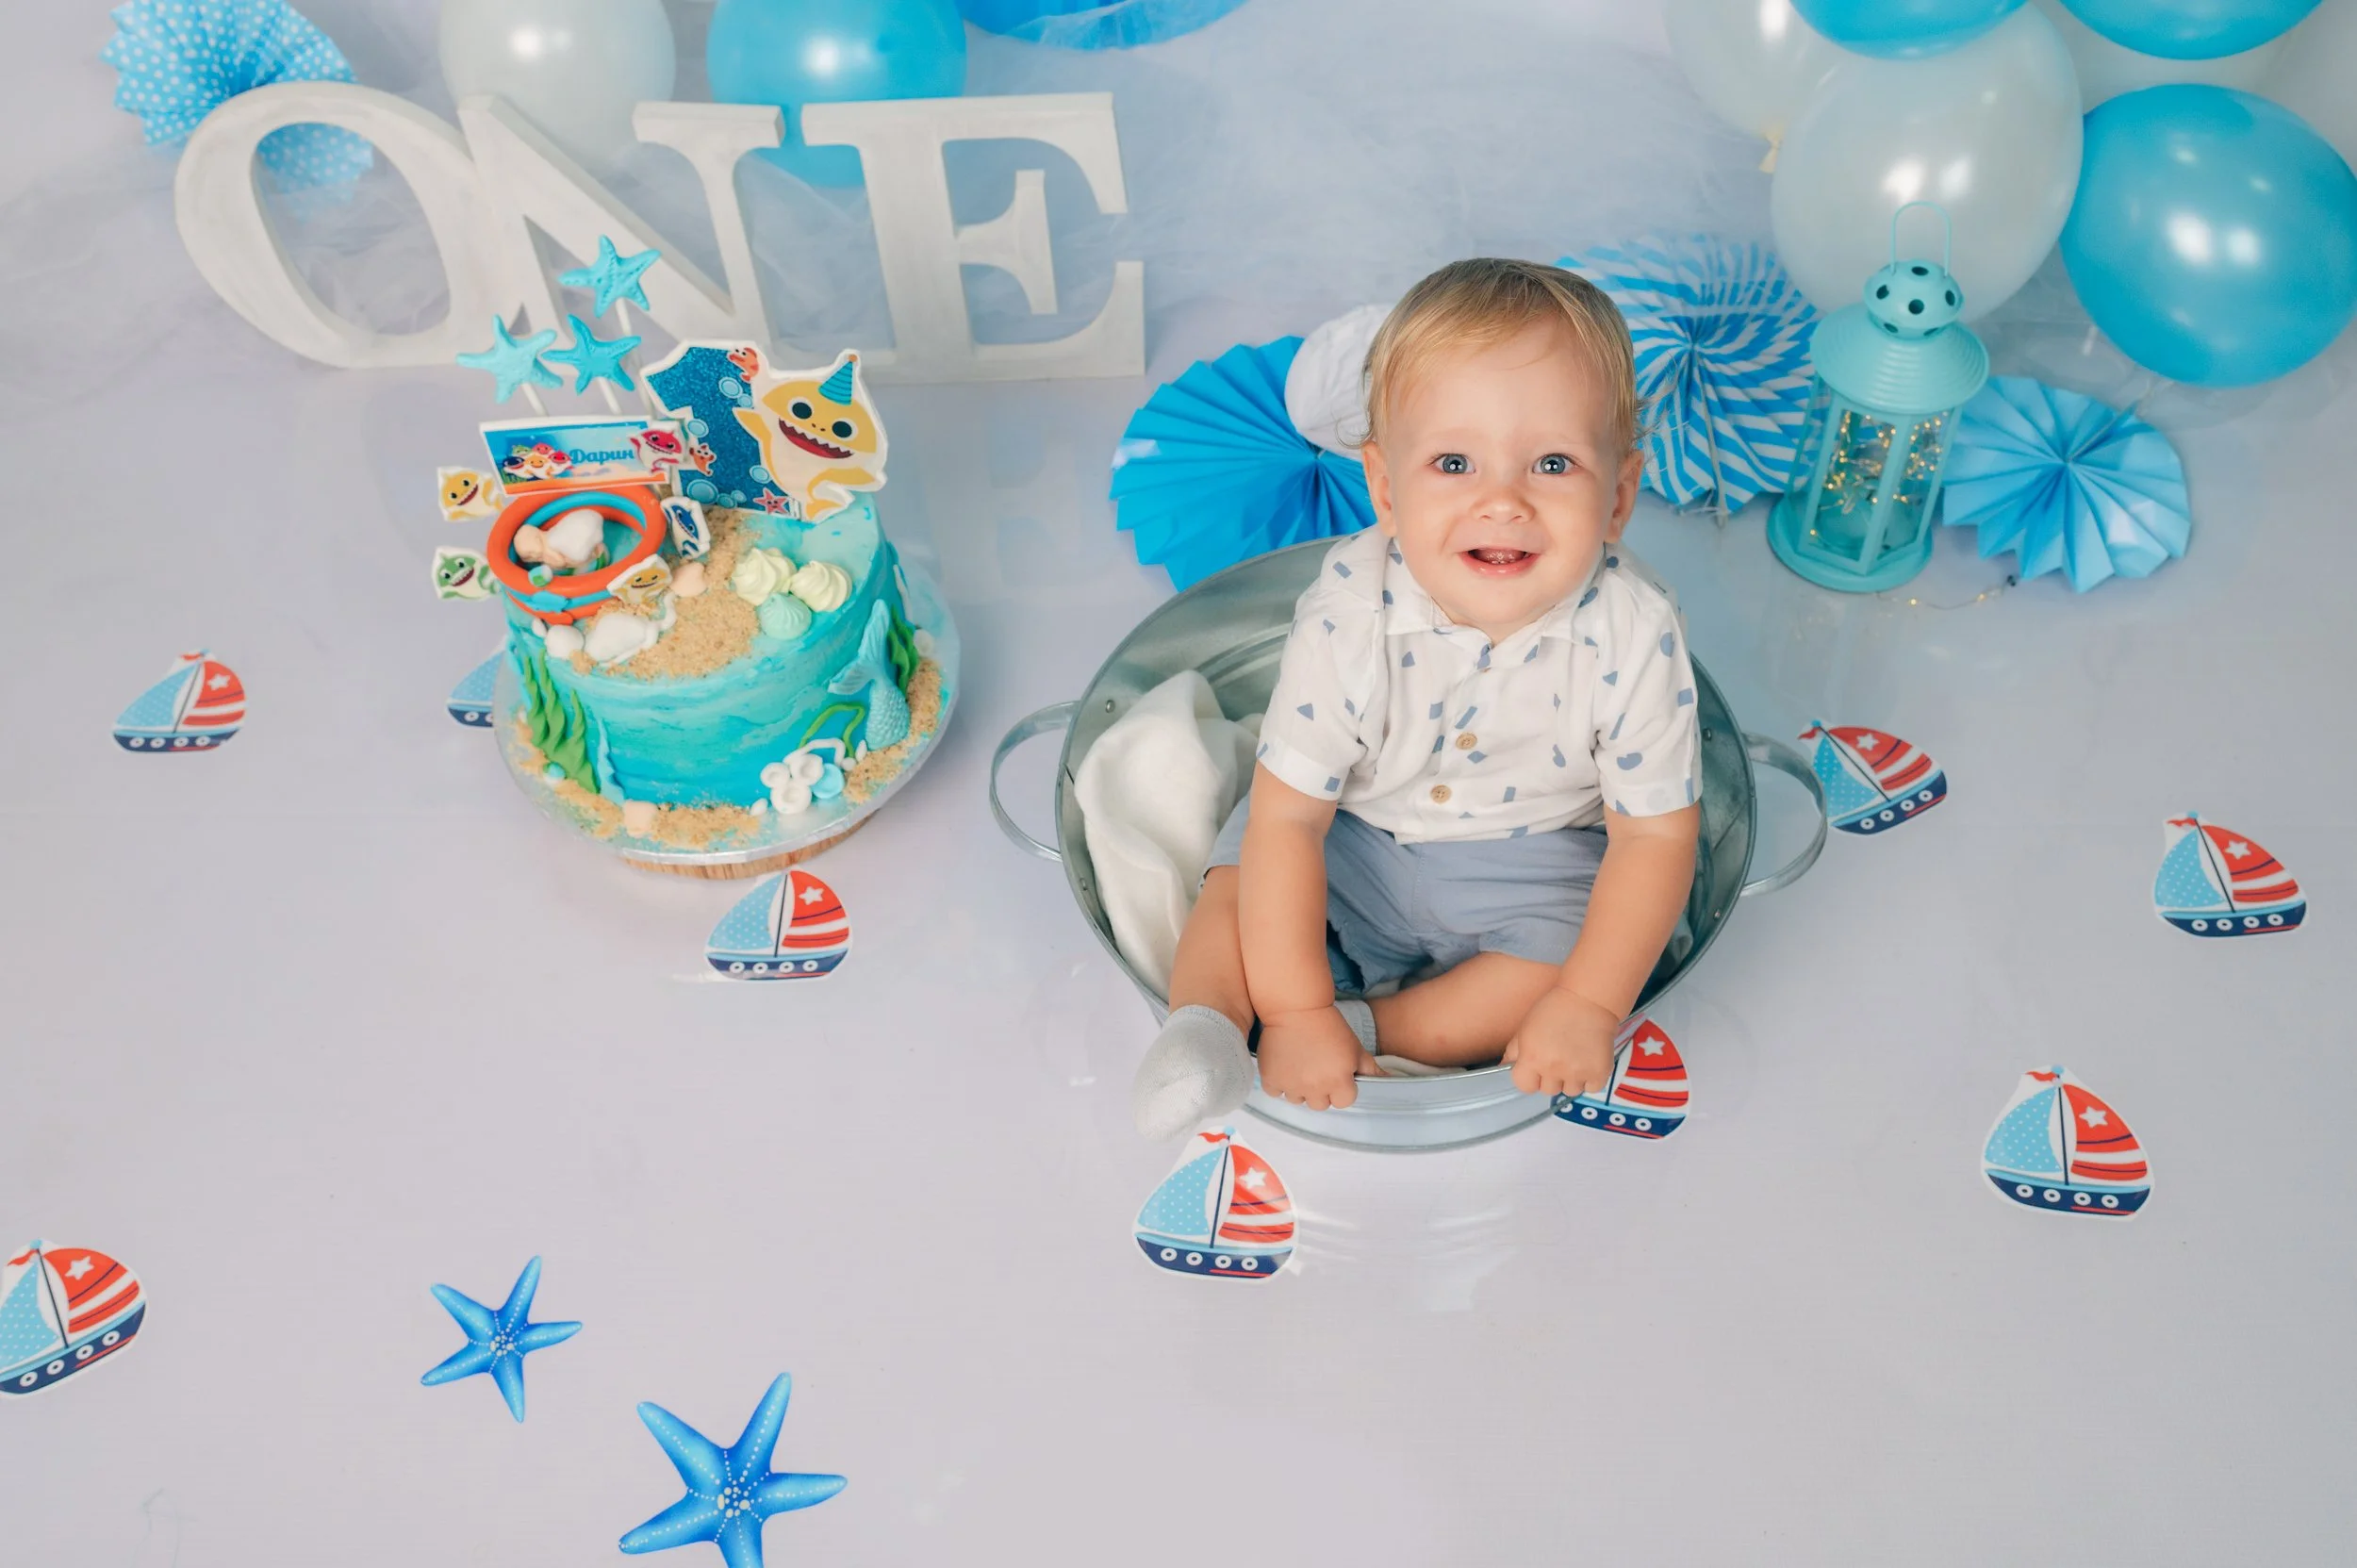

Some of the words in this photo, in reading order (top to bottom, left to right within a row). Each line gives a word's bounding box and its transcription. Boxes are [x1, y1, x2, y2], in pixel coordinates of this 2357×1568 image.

[174, 80, 1145, 383] ONE
[569, 448, 635, 465] Дарин
[643, 343, 794, 519] 1
